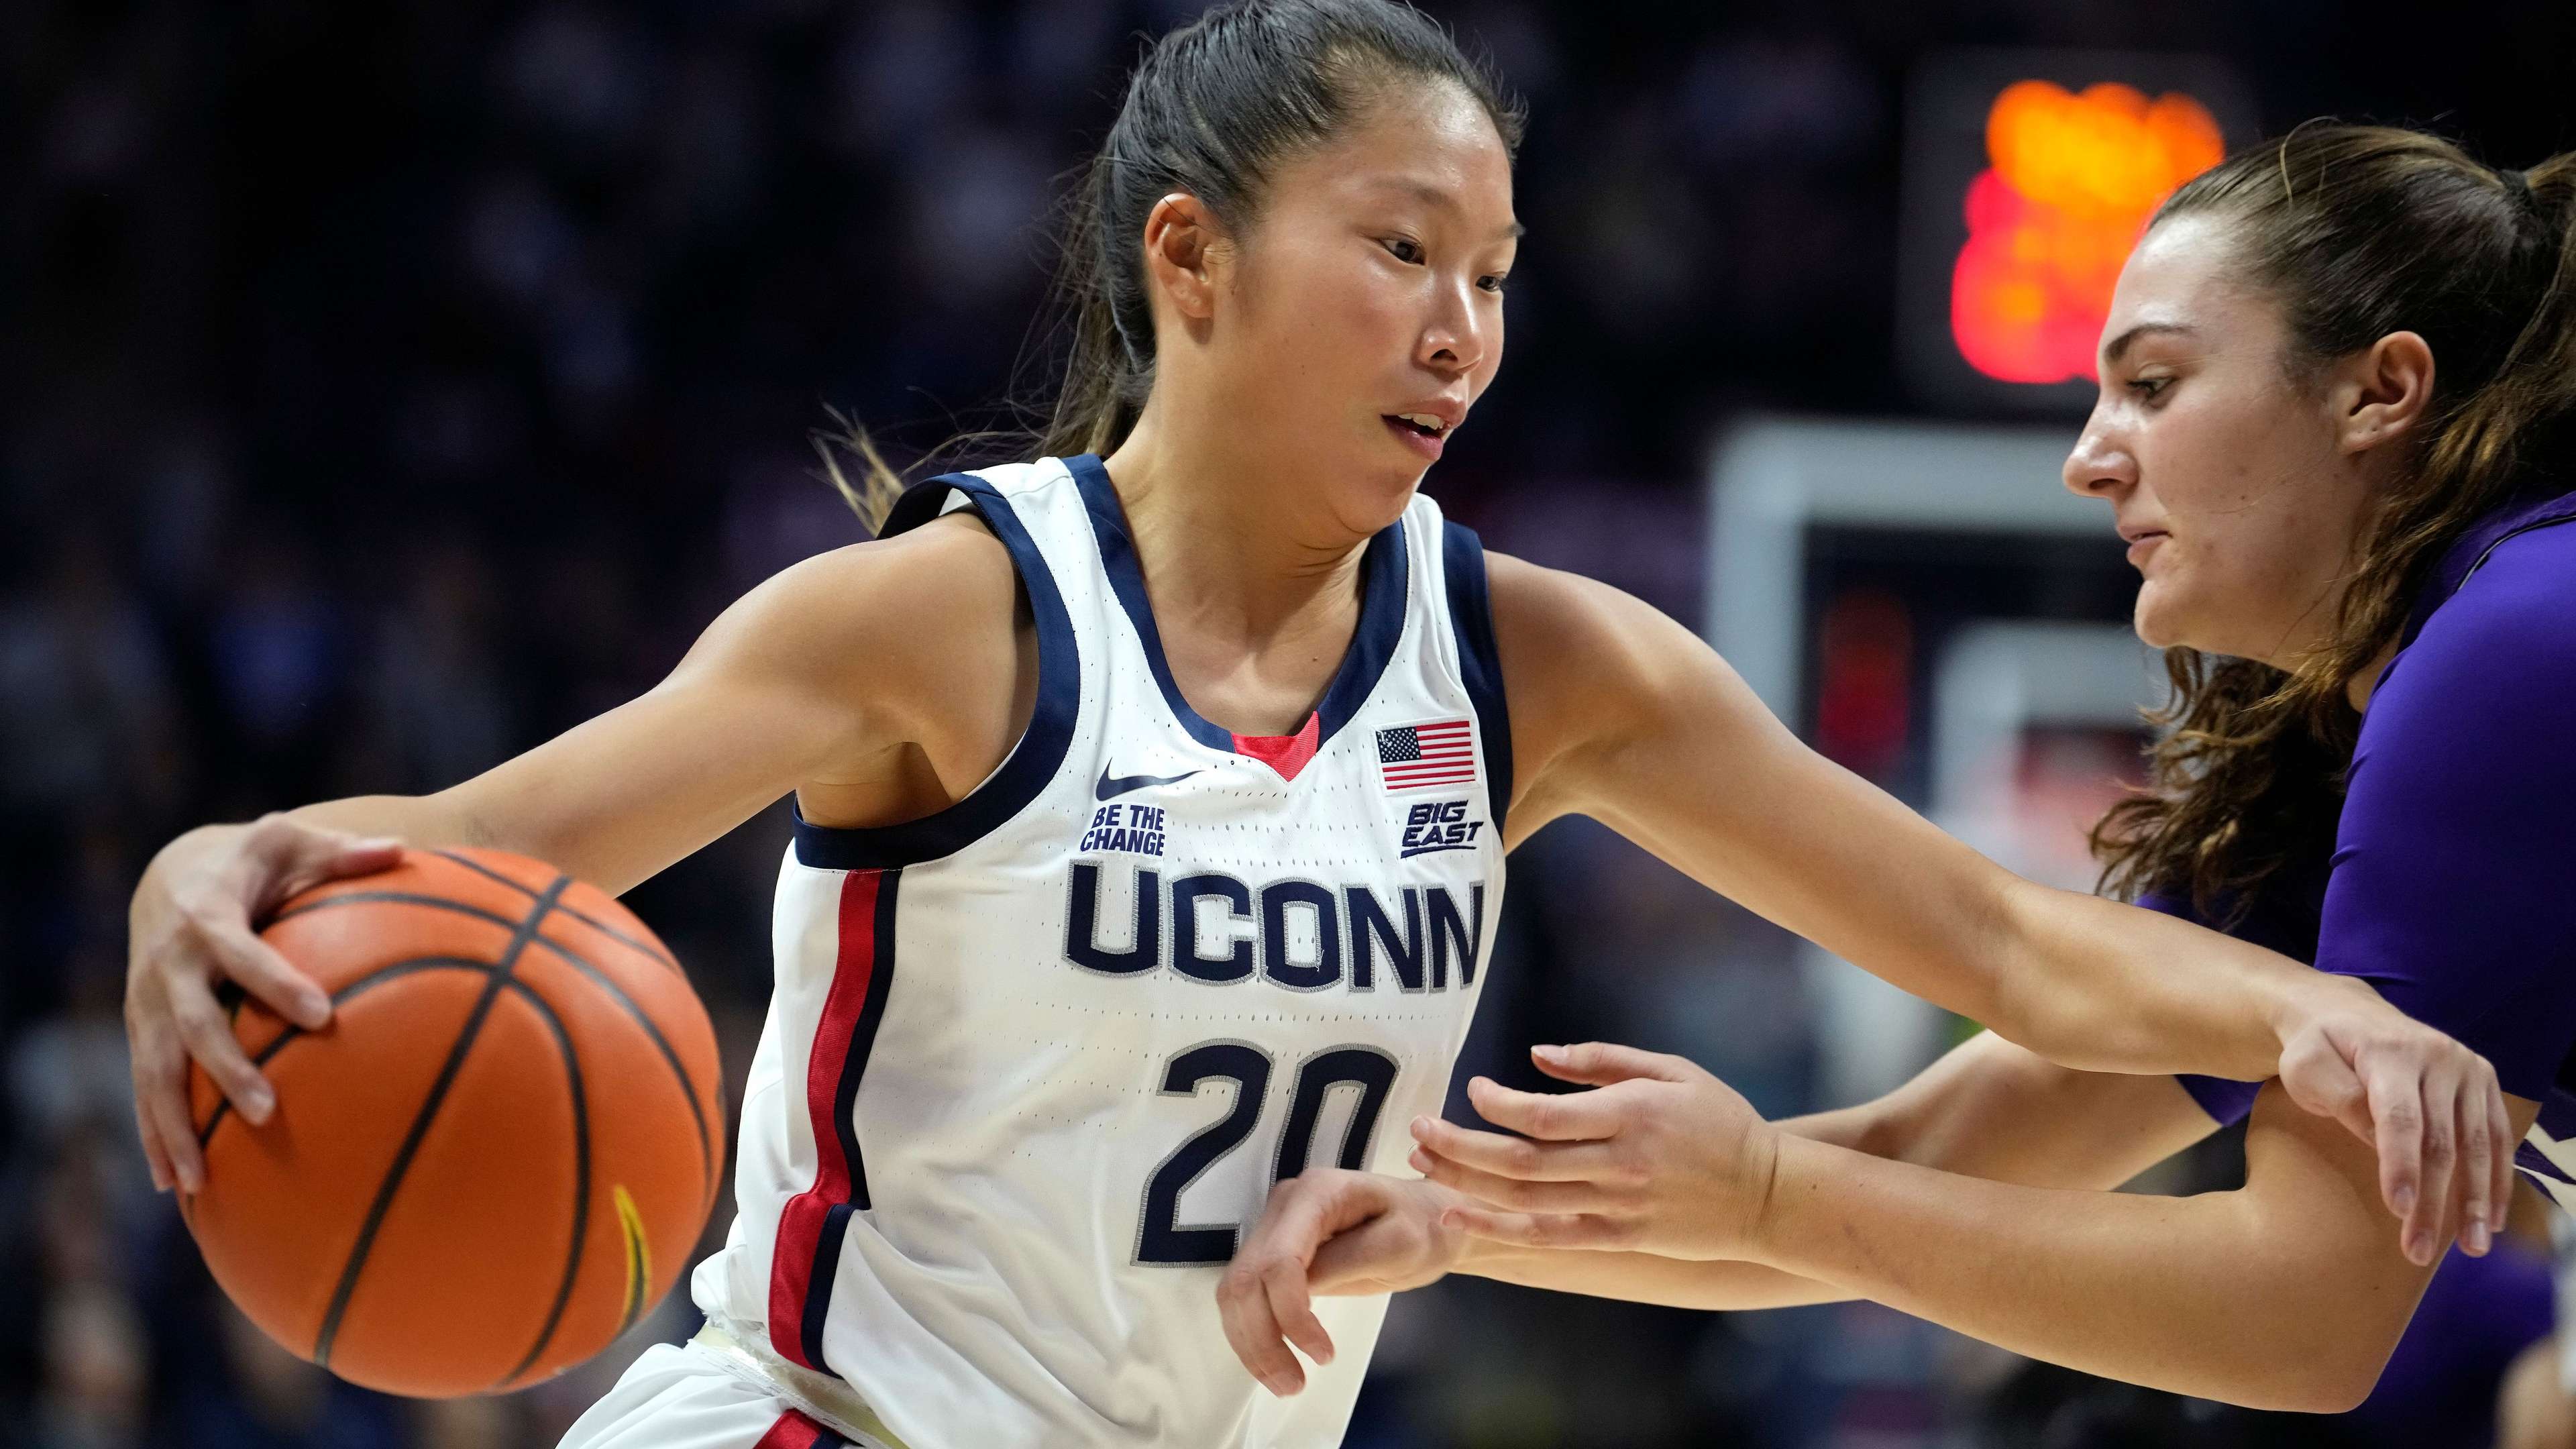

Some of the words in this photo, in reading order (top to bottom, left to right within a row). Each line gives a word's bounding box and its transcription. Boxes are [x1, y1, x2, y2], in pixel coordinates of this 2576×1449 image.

[1091, 804, 1122, 828] BE
[1130, 805, 1165, 831] THE
[1407, 799, 1468, 826] BIG
[1080, 828, 1165, 857] CHANGE
[1401, 821, 1484, 847] EAST
[1062, 859, 1485, 994] UCONN
[1130, 1038, 1400, 1268] 20
